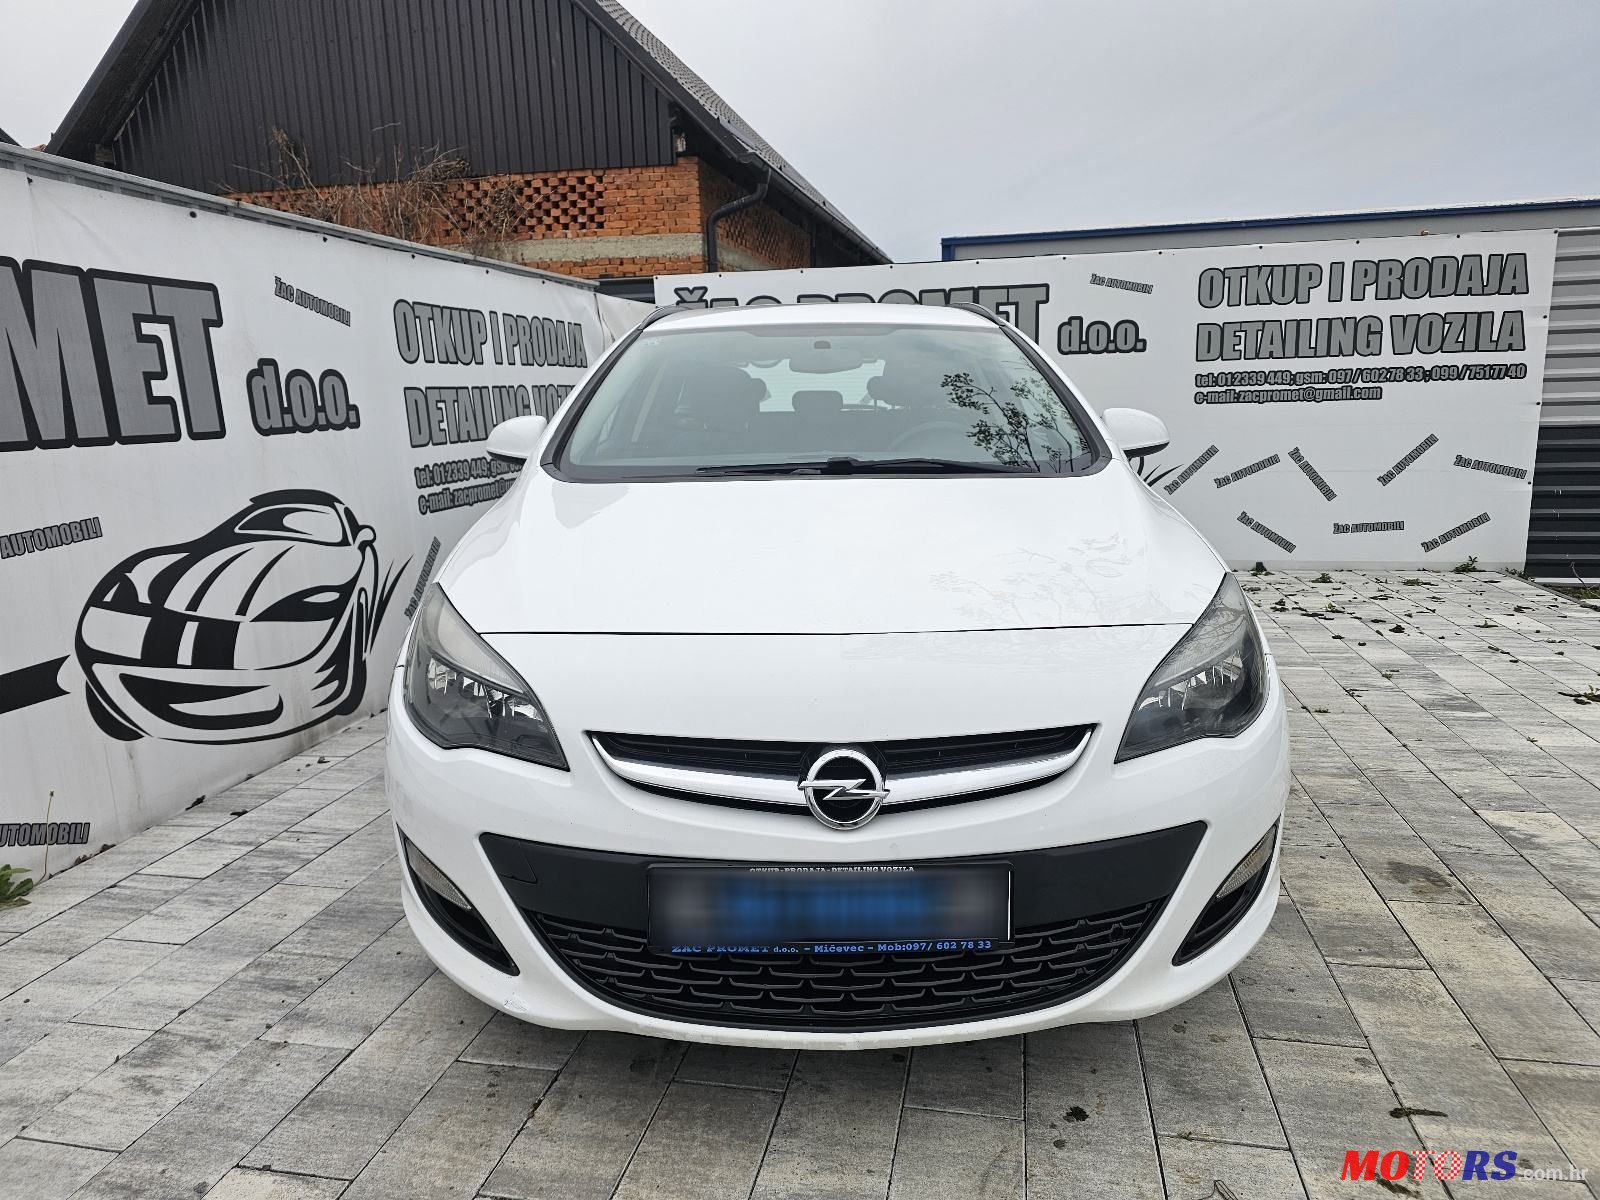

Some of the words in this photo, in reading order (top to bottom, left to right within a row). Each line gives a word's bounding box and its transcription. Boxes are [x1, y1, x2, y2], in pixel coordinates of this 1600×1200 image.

[1105, 277, 1153, 294] AUTOMOBILI
[1198, 263, 1323, 308] OTKUP
[1328, 261, 1345, 303] I
[1350, 252, 1529, 301] PRODAJA
[275, 276, 294, 302] ŽAC
[295, 288, 351, 327] AUTOMOBILI
[393, 299, 487, 365] OTKUP
[489, 311, 503, 365] I
[502, 313, 588, 368] PRODAJA
[1057, 315, 1148, 355] d.o.o.
[1195, 315, 1384, 362] DETAILING
[1390, 310, 1526, 355] VOZILA
[246, 357, 361, 436] d.o.o.
[1194, 389, 1238, 404] e-mail:
[1238, 385, 1383, 404] zacpromet@gmail.com
[1195, 373, 1216, 387] tel:
[1295, 371, 1327, 386] gsm:
[414, 464, 433, 489] tel:
[1163, 479, 1182, 495] ŽAC
[1177, 444, 1220, 484] AUTOMOBILI
[1213, 476, 1232, 489] ŽAC
[1230, 453, 1281, 483] AUTOMOBILI
[1287, 446, 1306, 464] ŽAC
[1298, 460, 1337, 502] AUTOMOBILI
[1377, 470, 1397, 487] ŽAC
[1392, 433, 1439, 475] AUTOMOBILI
[1453, 454, 1472, 469] ŽAC
[1471, 459, 1528, 480] AUTOMOBILI
[418, 487, 454, 515] e-mail:
[0, 516, 103, 559] AUTOMOBILI
[1236, 510, 1255, 527] ŽAC
[1250, 521, 1297, 554] AUTOMOBILI
[1333, 522, 1351, 534] ŽAC
[1350, 520, 1405, 534] AUTOMOBILI
[1421, 539, 1440, 553] ŽAC
[1438, 511, 1491, 545] AUTOMOBILI
[773, 945, 799, 953] d.o.o.
[814, 943, 864, 953] Mičevec
[936, 941, 957, 950] 602
[960, 941, 974, 949] 78
[977, 940, 992, 949] 33
